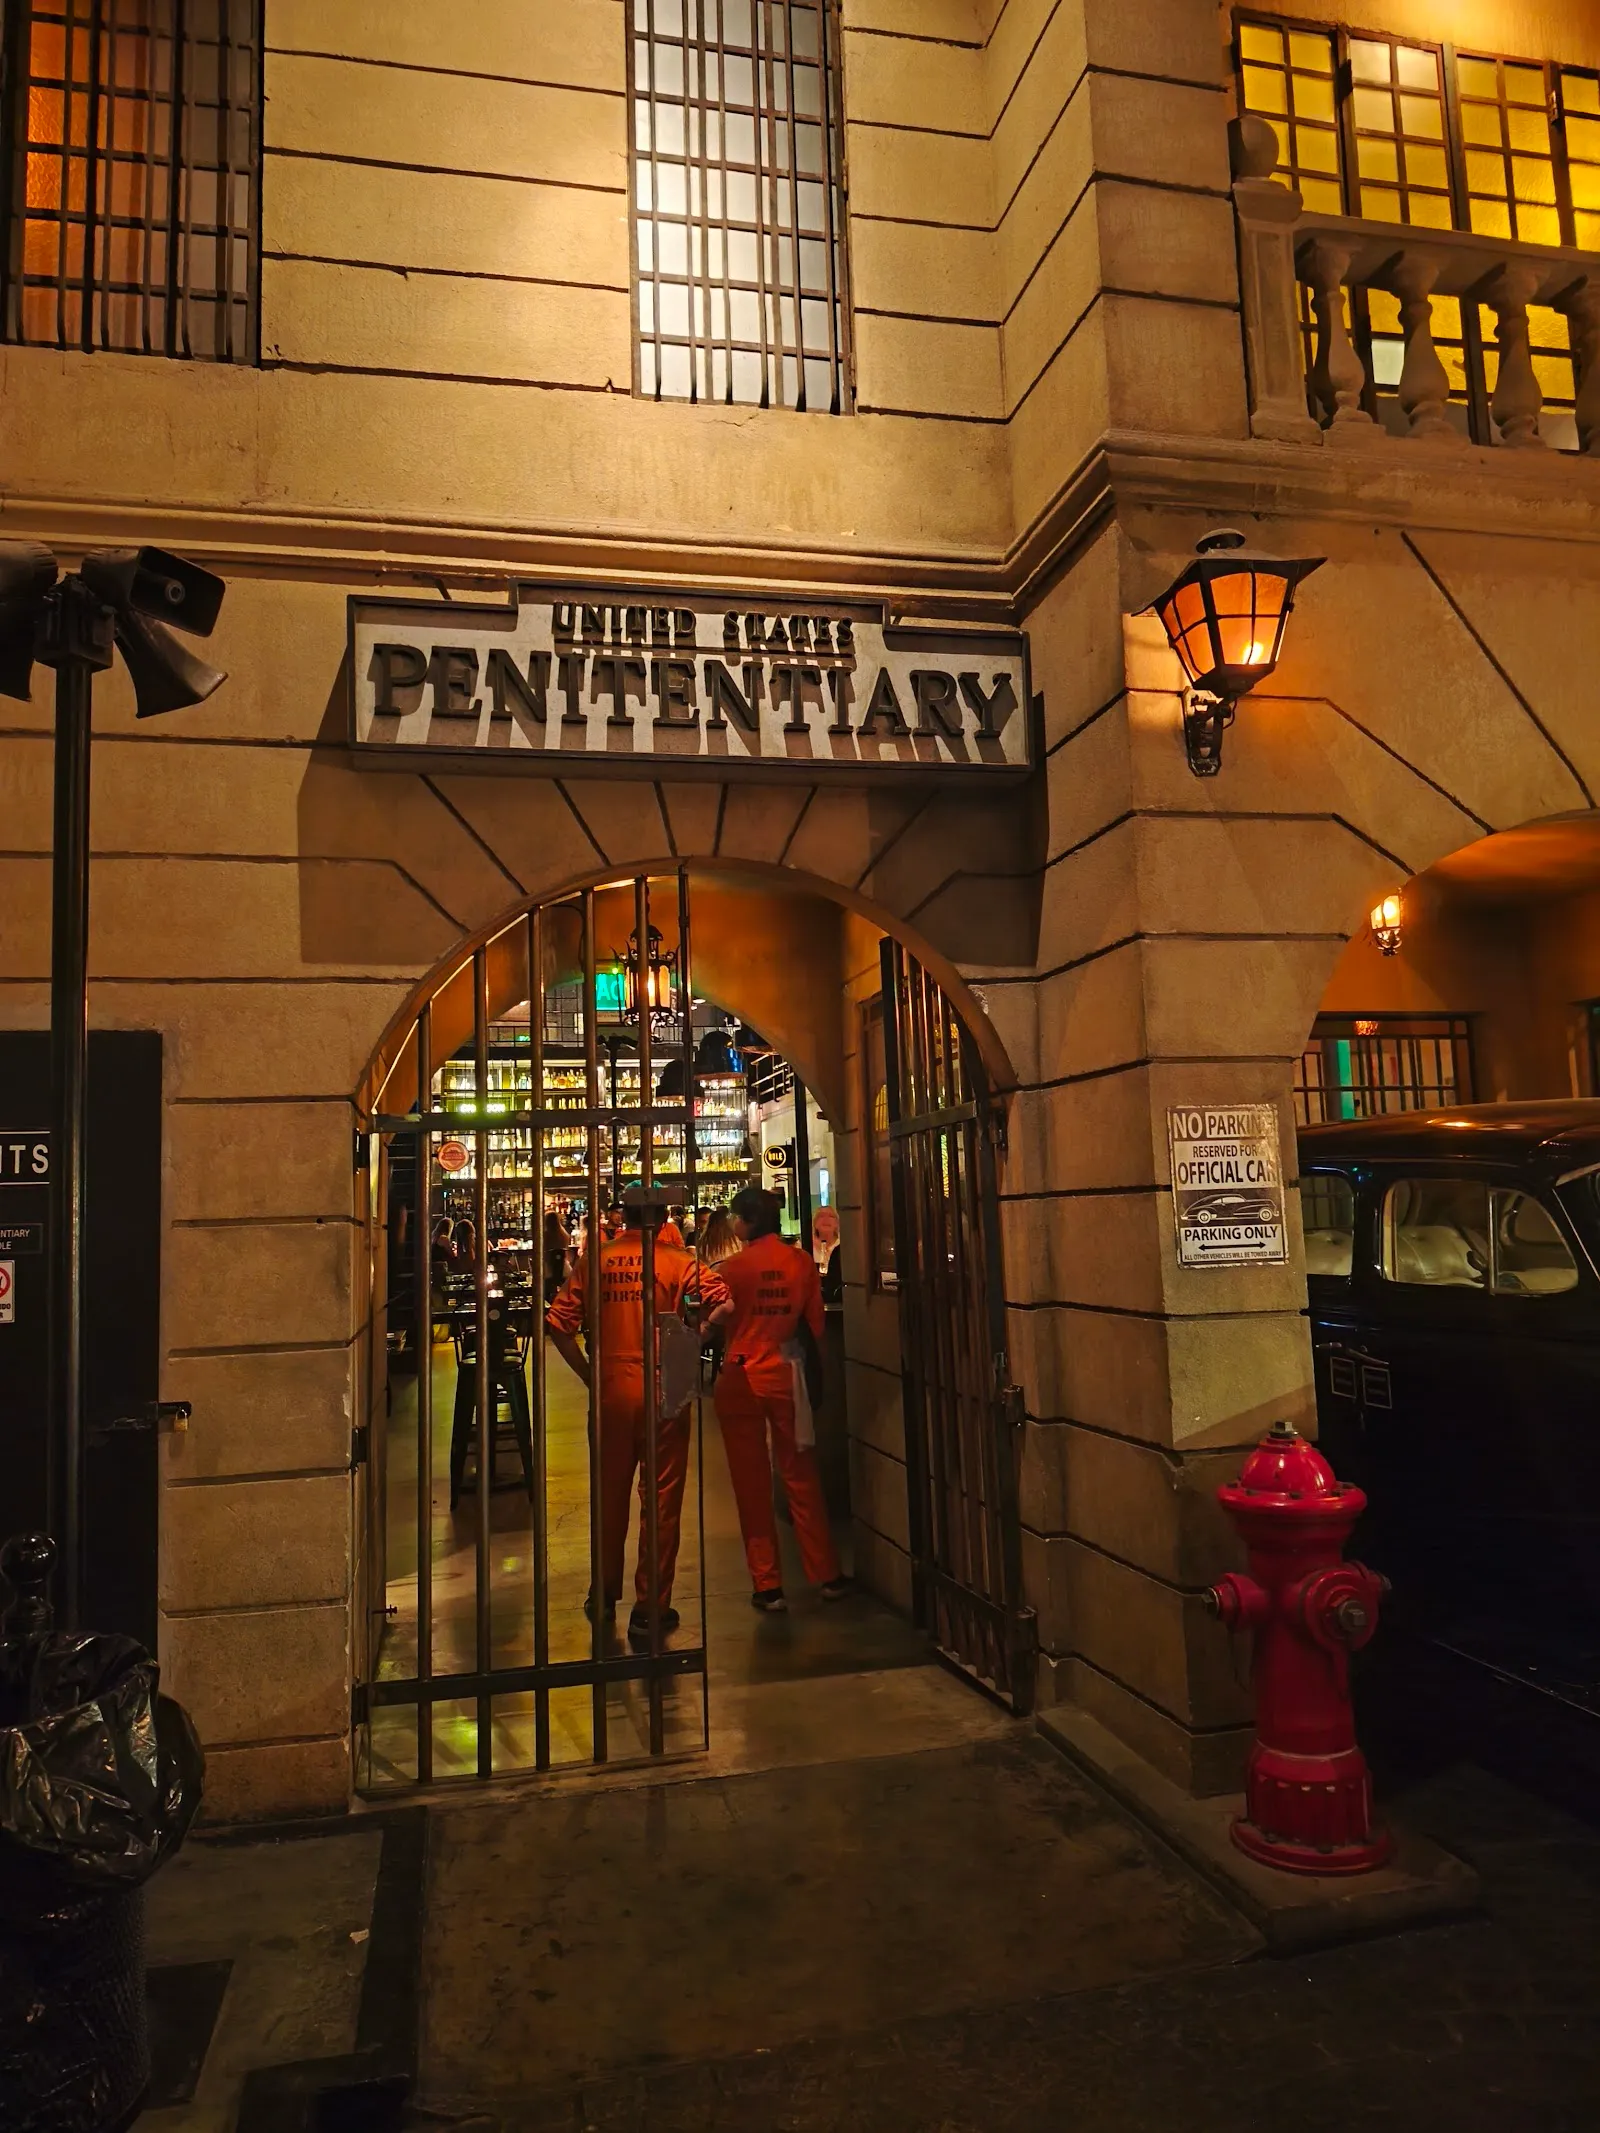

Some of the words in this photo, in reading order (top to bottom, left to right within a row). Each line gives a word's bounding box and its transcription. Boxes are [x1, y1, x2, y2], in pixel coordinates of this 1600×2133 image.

[552, 600, 697, 635] UNITED
[723, 609, 854, 646] STATES
[373, 643, 1012, 739] PENITENTIARY
[1173, 1112, 1203, 1139] NO
[1207, 1113, 1272, 1136] PARKIN
[1193, 1145, 1238, 1158] RESERVED
[1240, 1144, 1258, 1157] FOR
[1177, 1160, 1244, 1185] OFFICIAL
[1184, 1227, 1241, 1242] PARKING
[1244, 1225, 1278, 1240] ONLY
[607, 1255, 643, 1267] STAT
